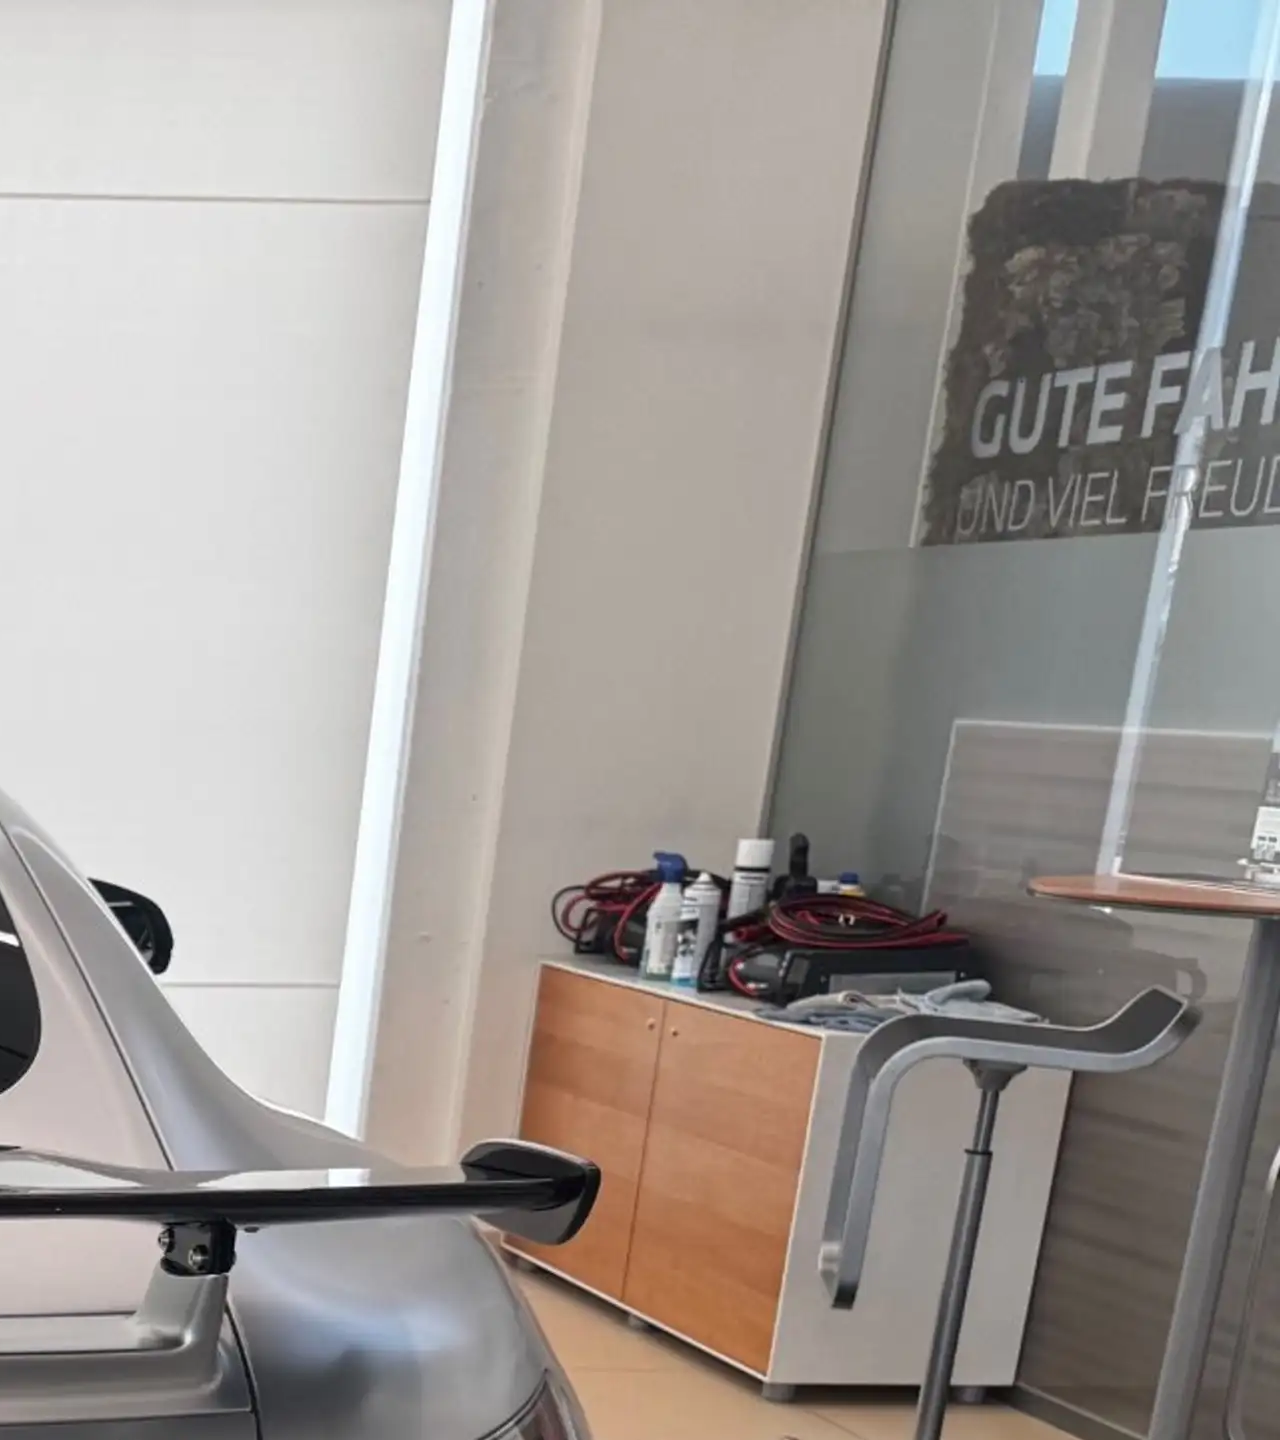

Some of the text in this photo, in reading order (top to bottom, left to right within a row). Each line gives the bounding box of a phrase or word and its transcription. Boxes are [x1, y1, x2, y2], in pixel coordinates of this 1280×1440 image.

[971, 360, 1133, 459] GUTE
[957, 478, 1036, 535] UND
[1048, 469, 1127, 528] VIEL
